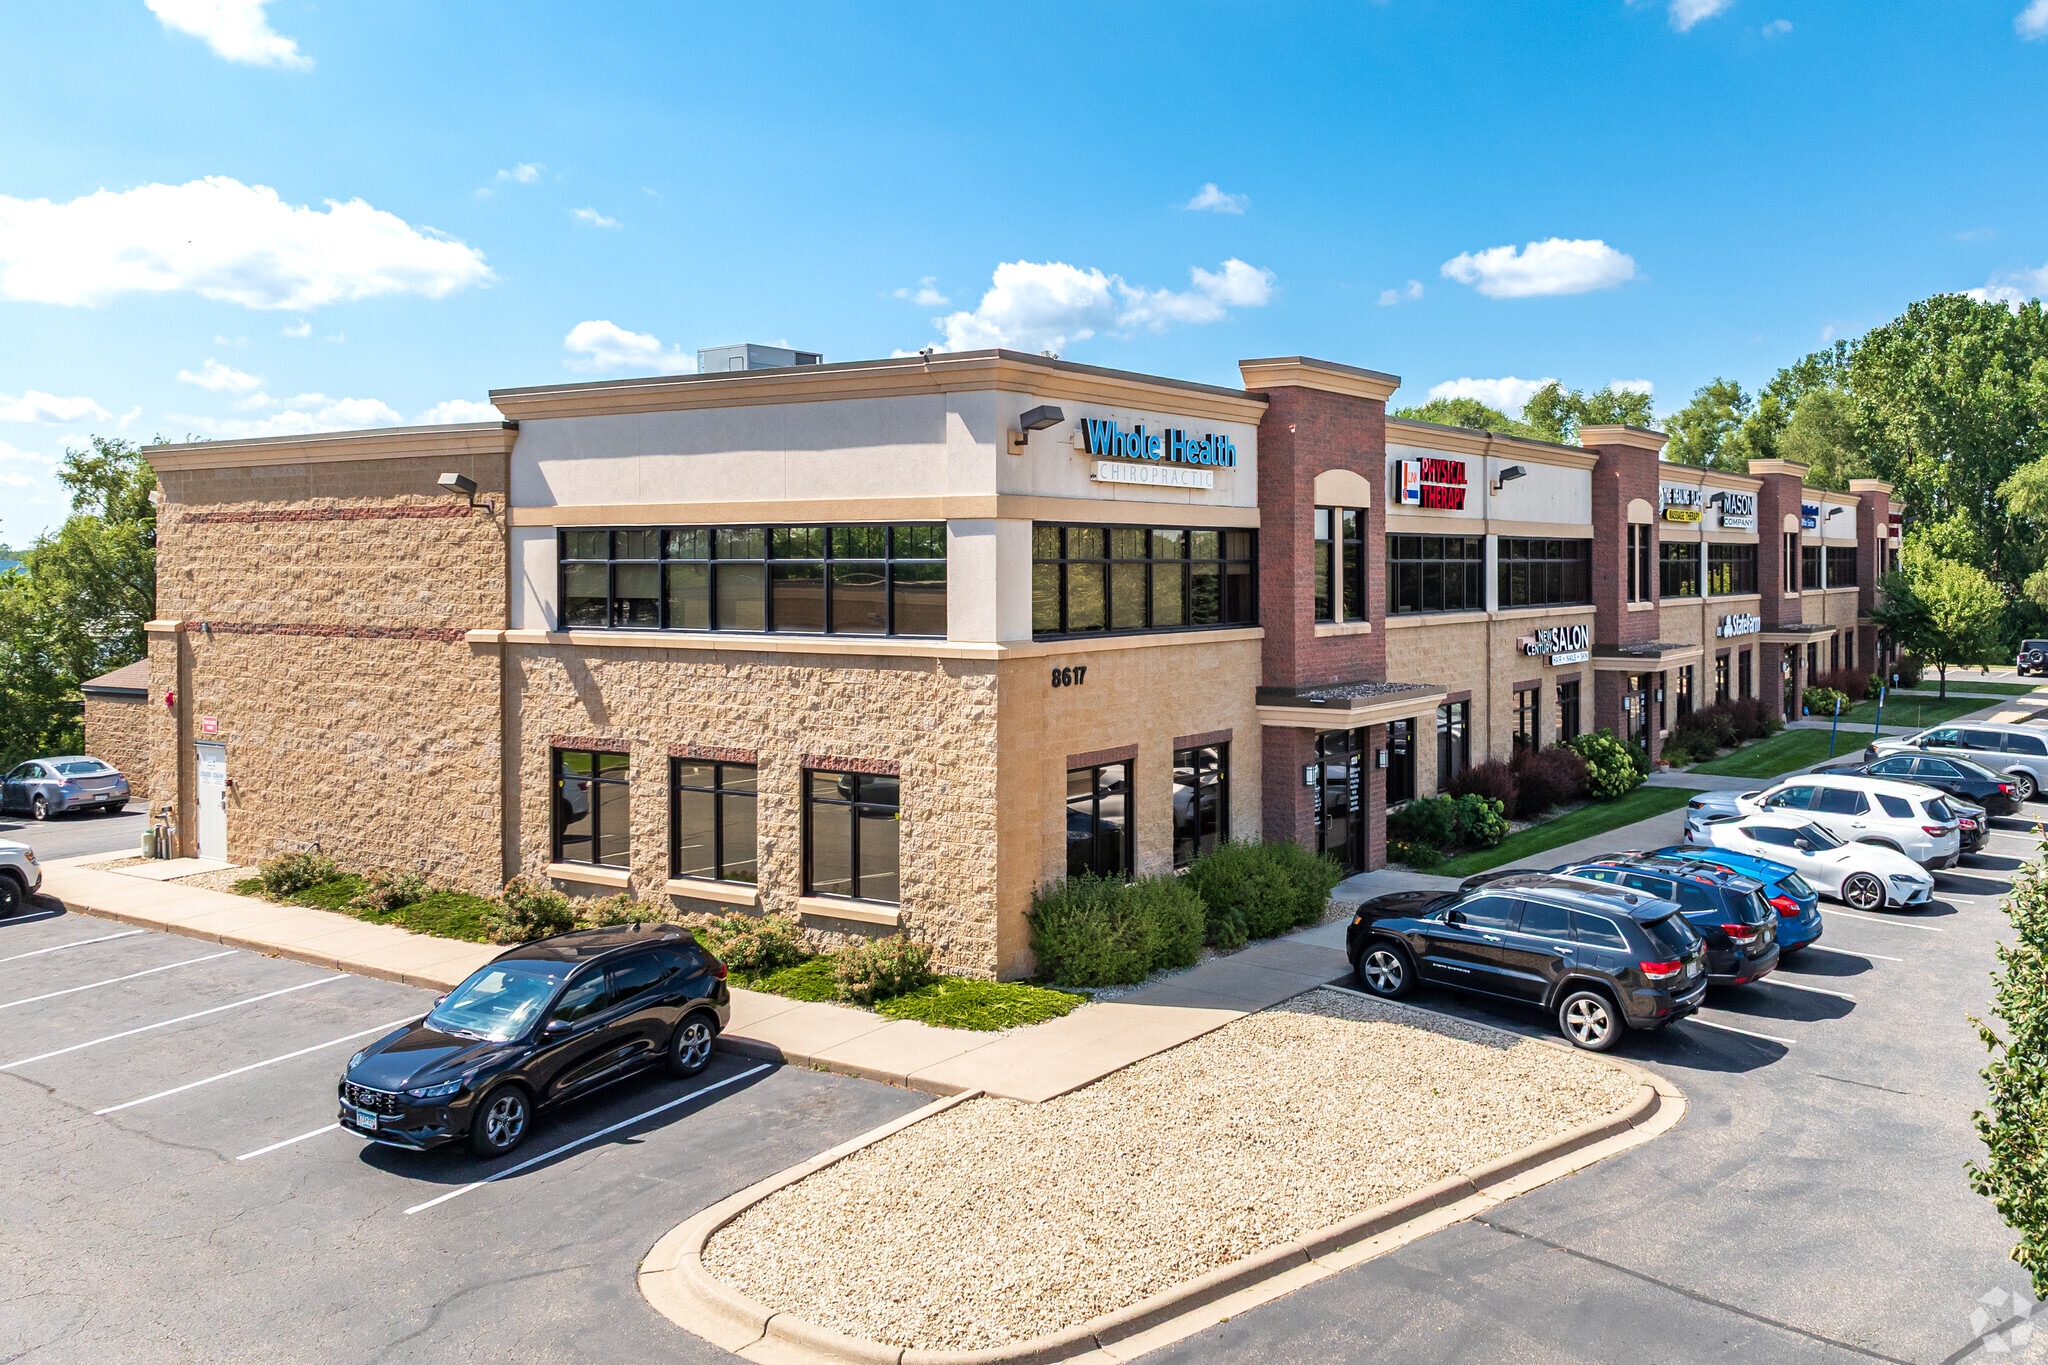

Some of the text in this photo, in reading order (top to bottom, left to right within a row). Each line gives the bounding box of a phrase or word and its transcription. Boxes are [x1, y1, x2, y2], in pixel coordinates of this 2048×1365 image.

[1085, 418, 1236, 467] Whole Health
[1100, 463, 1213, 487] CHIROPRACTIC
[1421, 457, 1467, 485] PHYSICAL
[1422, 485, 1467, 511] THERAPY
[1723, 494, 1753, 515] MASON
[1724, 518, 1753, 526] COMPANY
[1526, 642, 1552, 656] CENTURY
[1538, 625, 1589, 652] NEW SALON
[1052, 666, 1087, 688] 8617
